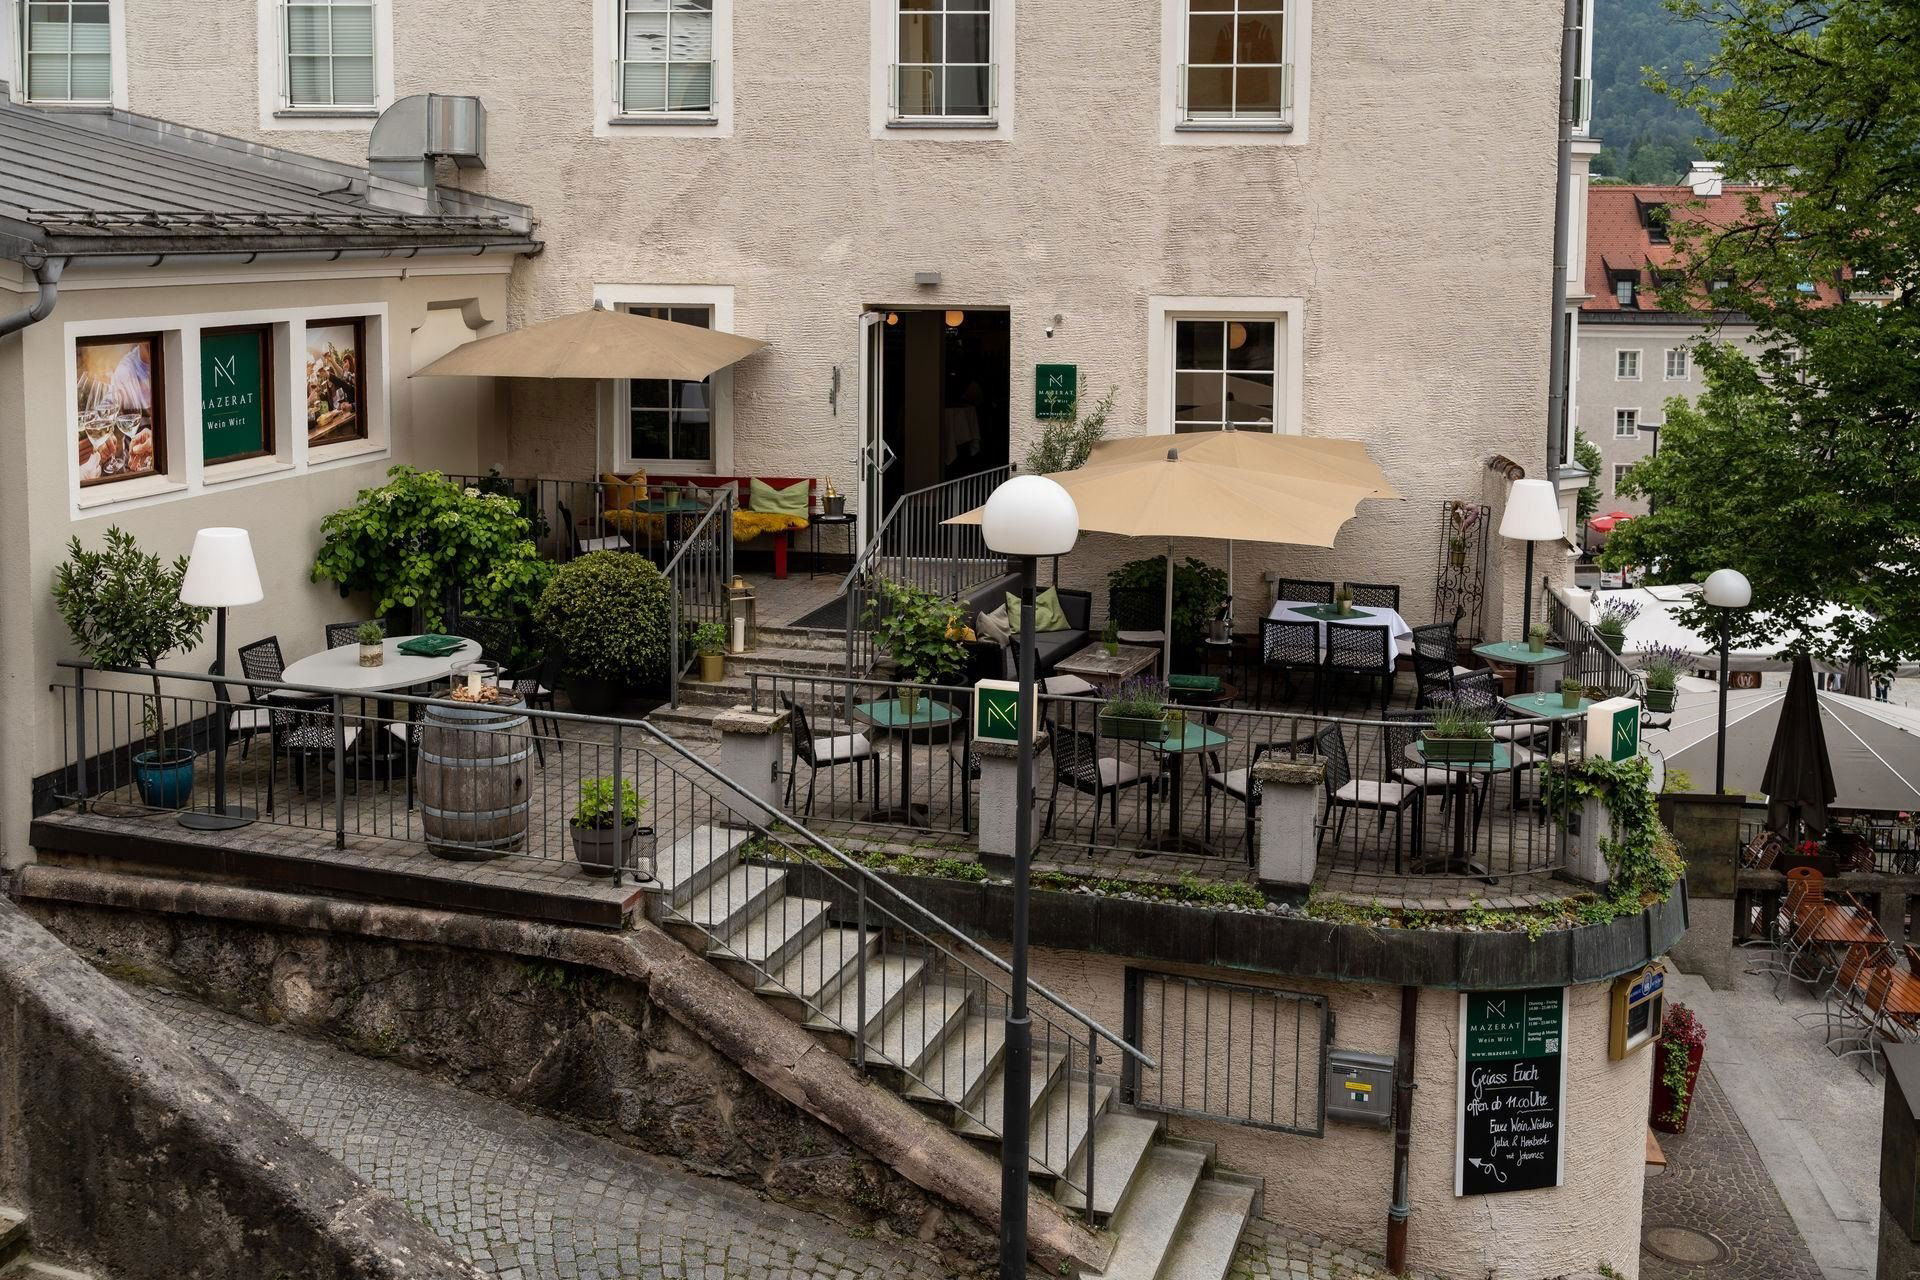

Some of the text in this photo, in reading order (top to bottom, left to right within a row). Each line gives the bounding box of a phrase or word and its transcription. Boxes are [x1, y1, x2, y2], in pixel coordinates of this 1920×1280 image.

[207, 417, 245, 430] Wein Wirt
[1470, 1022, 1520, 1032] MAZERAT
[1513, 1062, 1539, 1082] Euch
[1467, 1099, 1489, 1116] offen
[1491, 1096, 1502, 1111] ab
[1490, 1119, 1508, 1134] Eure
[1490, 1136, 1509, 1157] Julia
[1512, 1135, 1518, 1147] &
